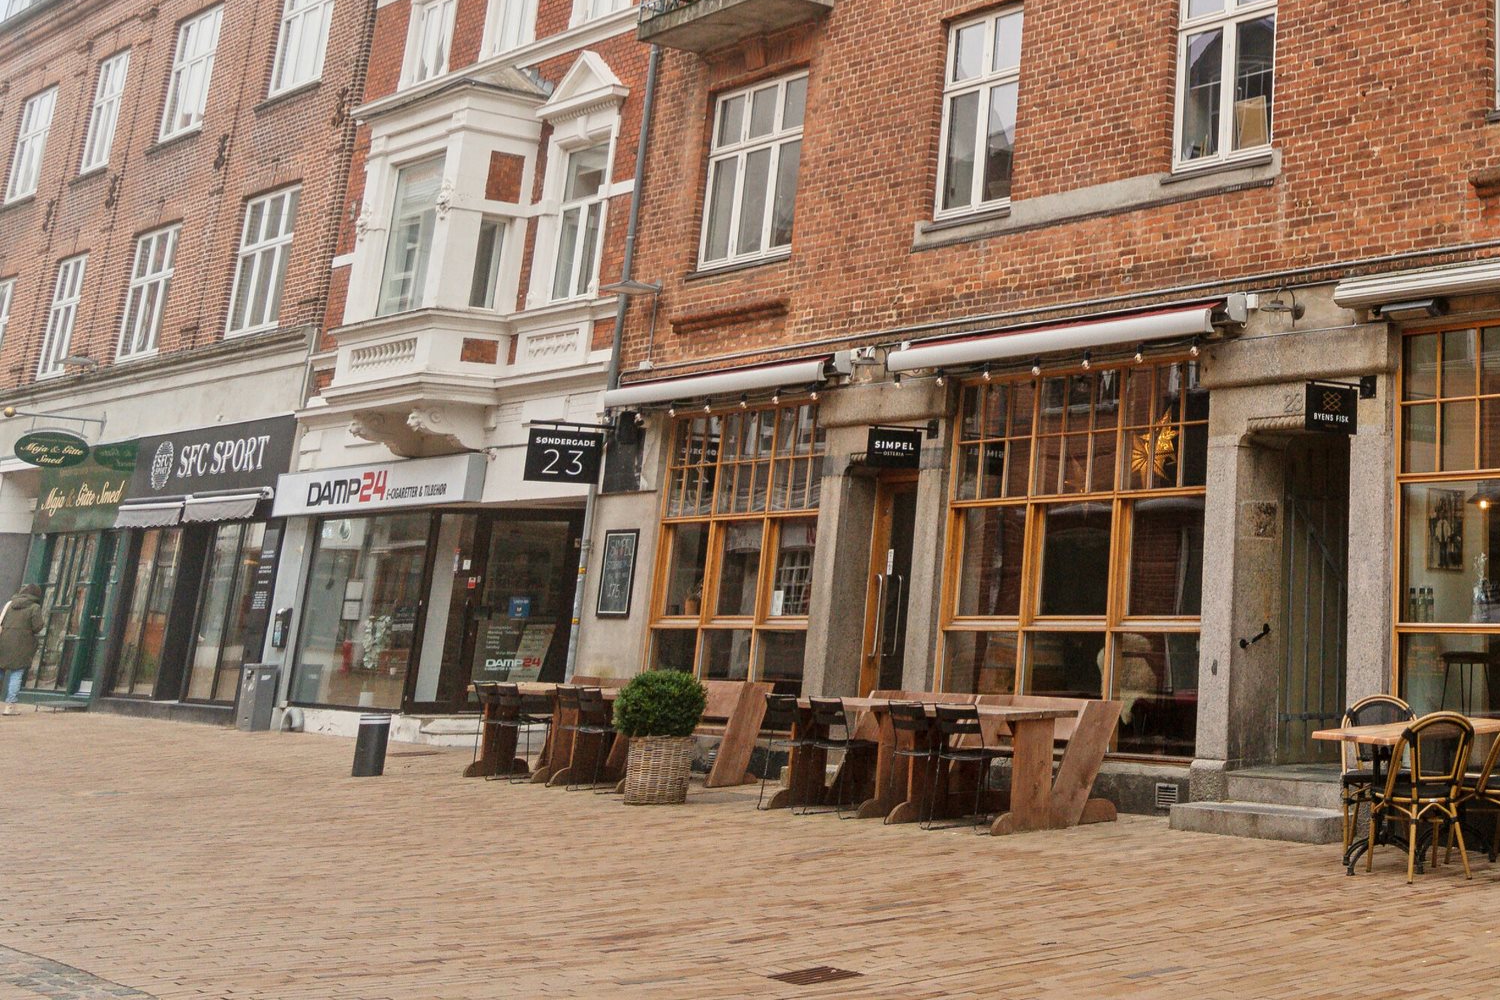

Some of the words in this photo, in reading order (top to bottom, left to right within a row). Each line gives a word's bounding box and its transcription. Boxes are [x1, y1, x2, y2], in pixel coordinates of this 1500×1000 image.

[1313, 412, 1334, 422] BYENS
[1335, 415, 1349, 423] FISK
[535, 436, 596, 447] SØNDERGADE
[874, 440, 914, 450] SIMPEL
[20, 442, 49, 455] Maja
[50, 445, 61, 453] &
[62, 444, 84, 456] Gitte
[36, 454, 65, 465] Smed
[177, 443, 211, 478] SFC
[210, 435, 271, 475] SPORT
[541, 448, 584, 476] 23
[306, 470, 388, 507] DAMP24
[386, 486, 418, 500] E-CIGARETTER
[418, 488, 423, 498] &
[424, 483, 447, 497] TILBEHØR
[41, 487, 66, 517] Maja
[75, 482, 96, 507] Gitte
[96, 480, 126, 505] Smed
